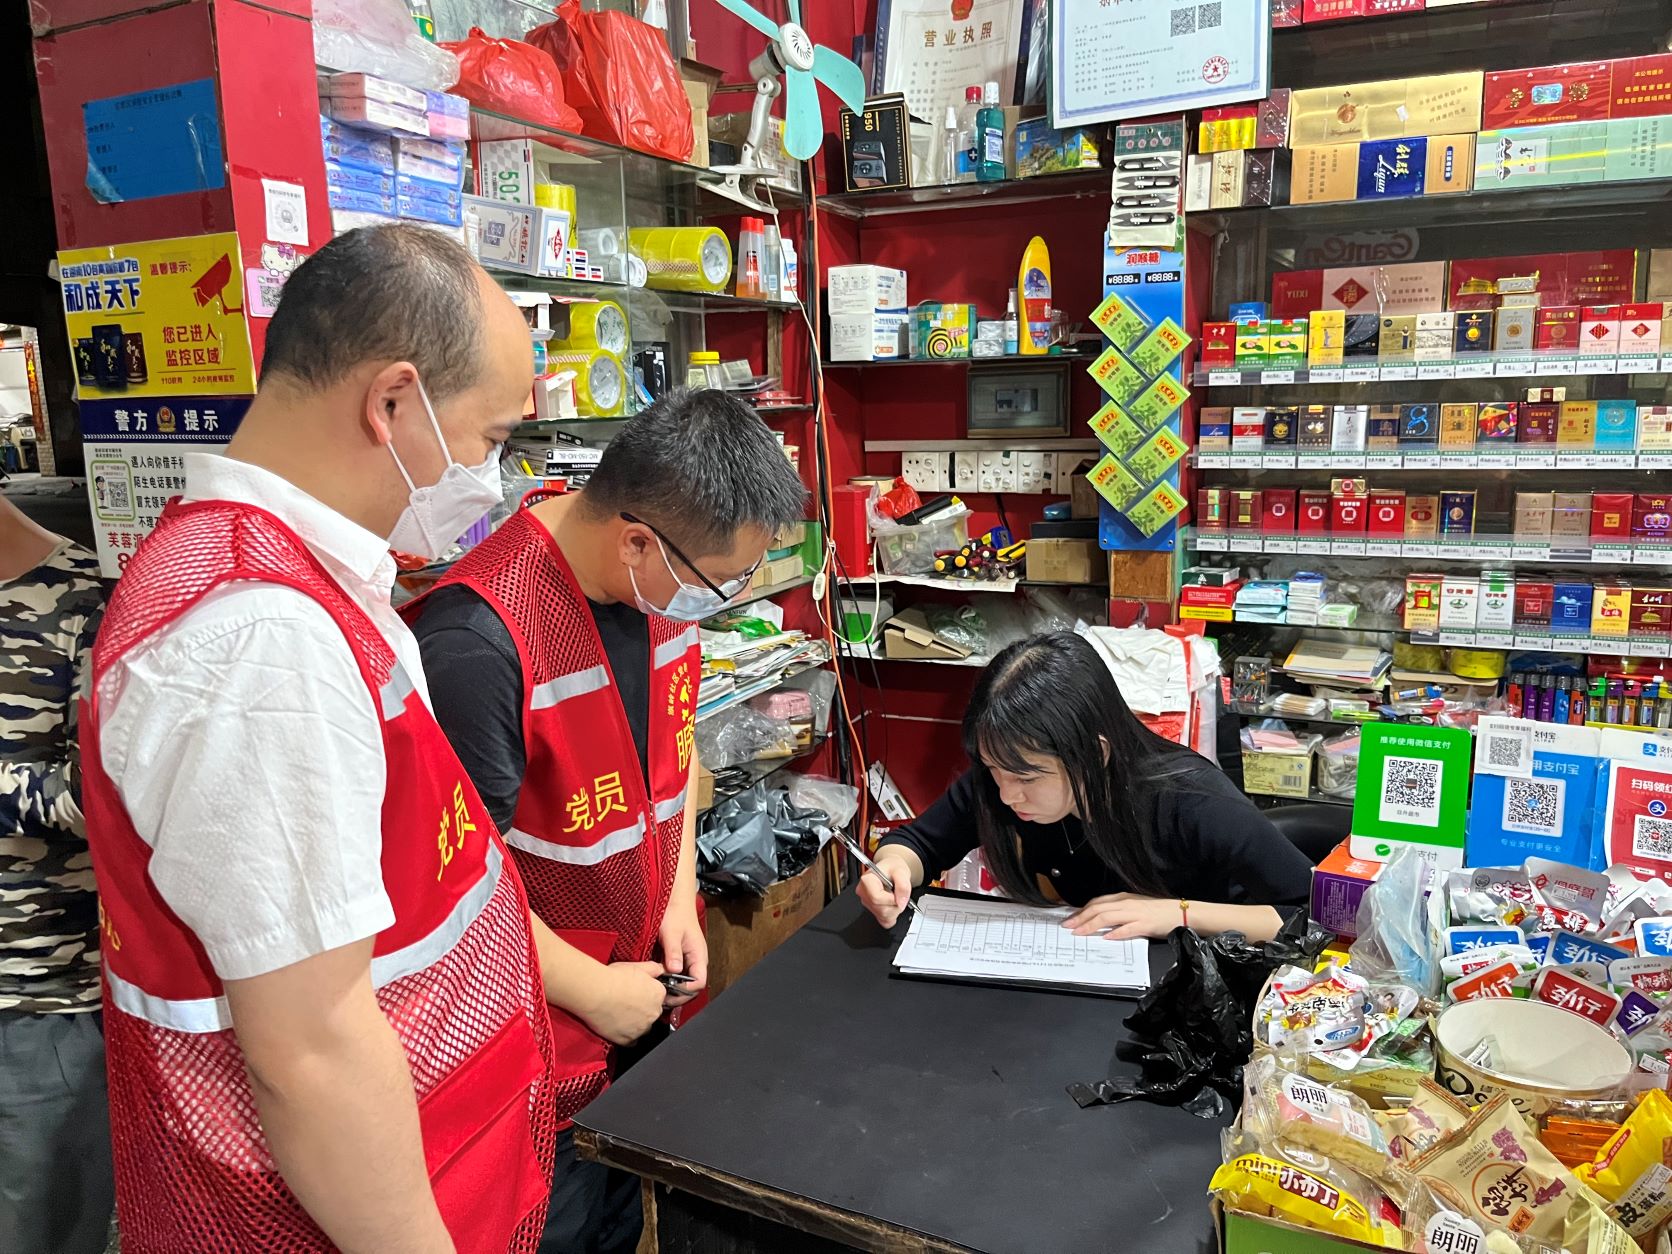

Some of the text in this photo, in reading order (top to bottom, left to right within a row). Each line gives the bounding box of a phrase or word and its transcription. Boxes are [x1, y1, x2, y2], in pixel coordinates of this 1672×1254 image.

[924, 22, 993, 48] 营业执照
[864, 111, 873, 132] 950
[1373, 154, 1398, 193] Liqun
[64, 278, 141, 312] 和成天下
[163, 323, 218, 343] 您已进入
[166, 347, 220, 367] 监控区域
[114, 409, 218, 432] 警方 提示
[1380, 736, 1451, 749] 推荐使用微信支付
[1533, 760, 1580, 775] 用支付宝
[562, 770, 629, 833] 党员
[437, 780, 477, 882] 党员
[1501, 838, 1561, 853] 专业支付更安全
[1291, 1085, 1328, 1105] 朗丽
[1235, 1157, 1338, 1207] mini 小布丁
[1431, 1226, 1480, 1254] 朗丽
